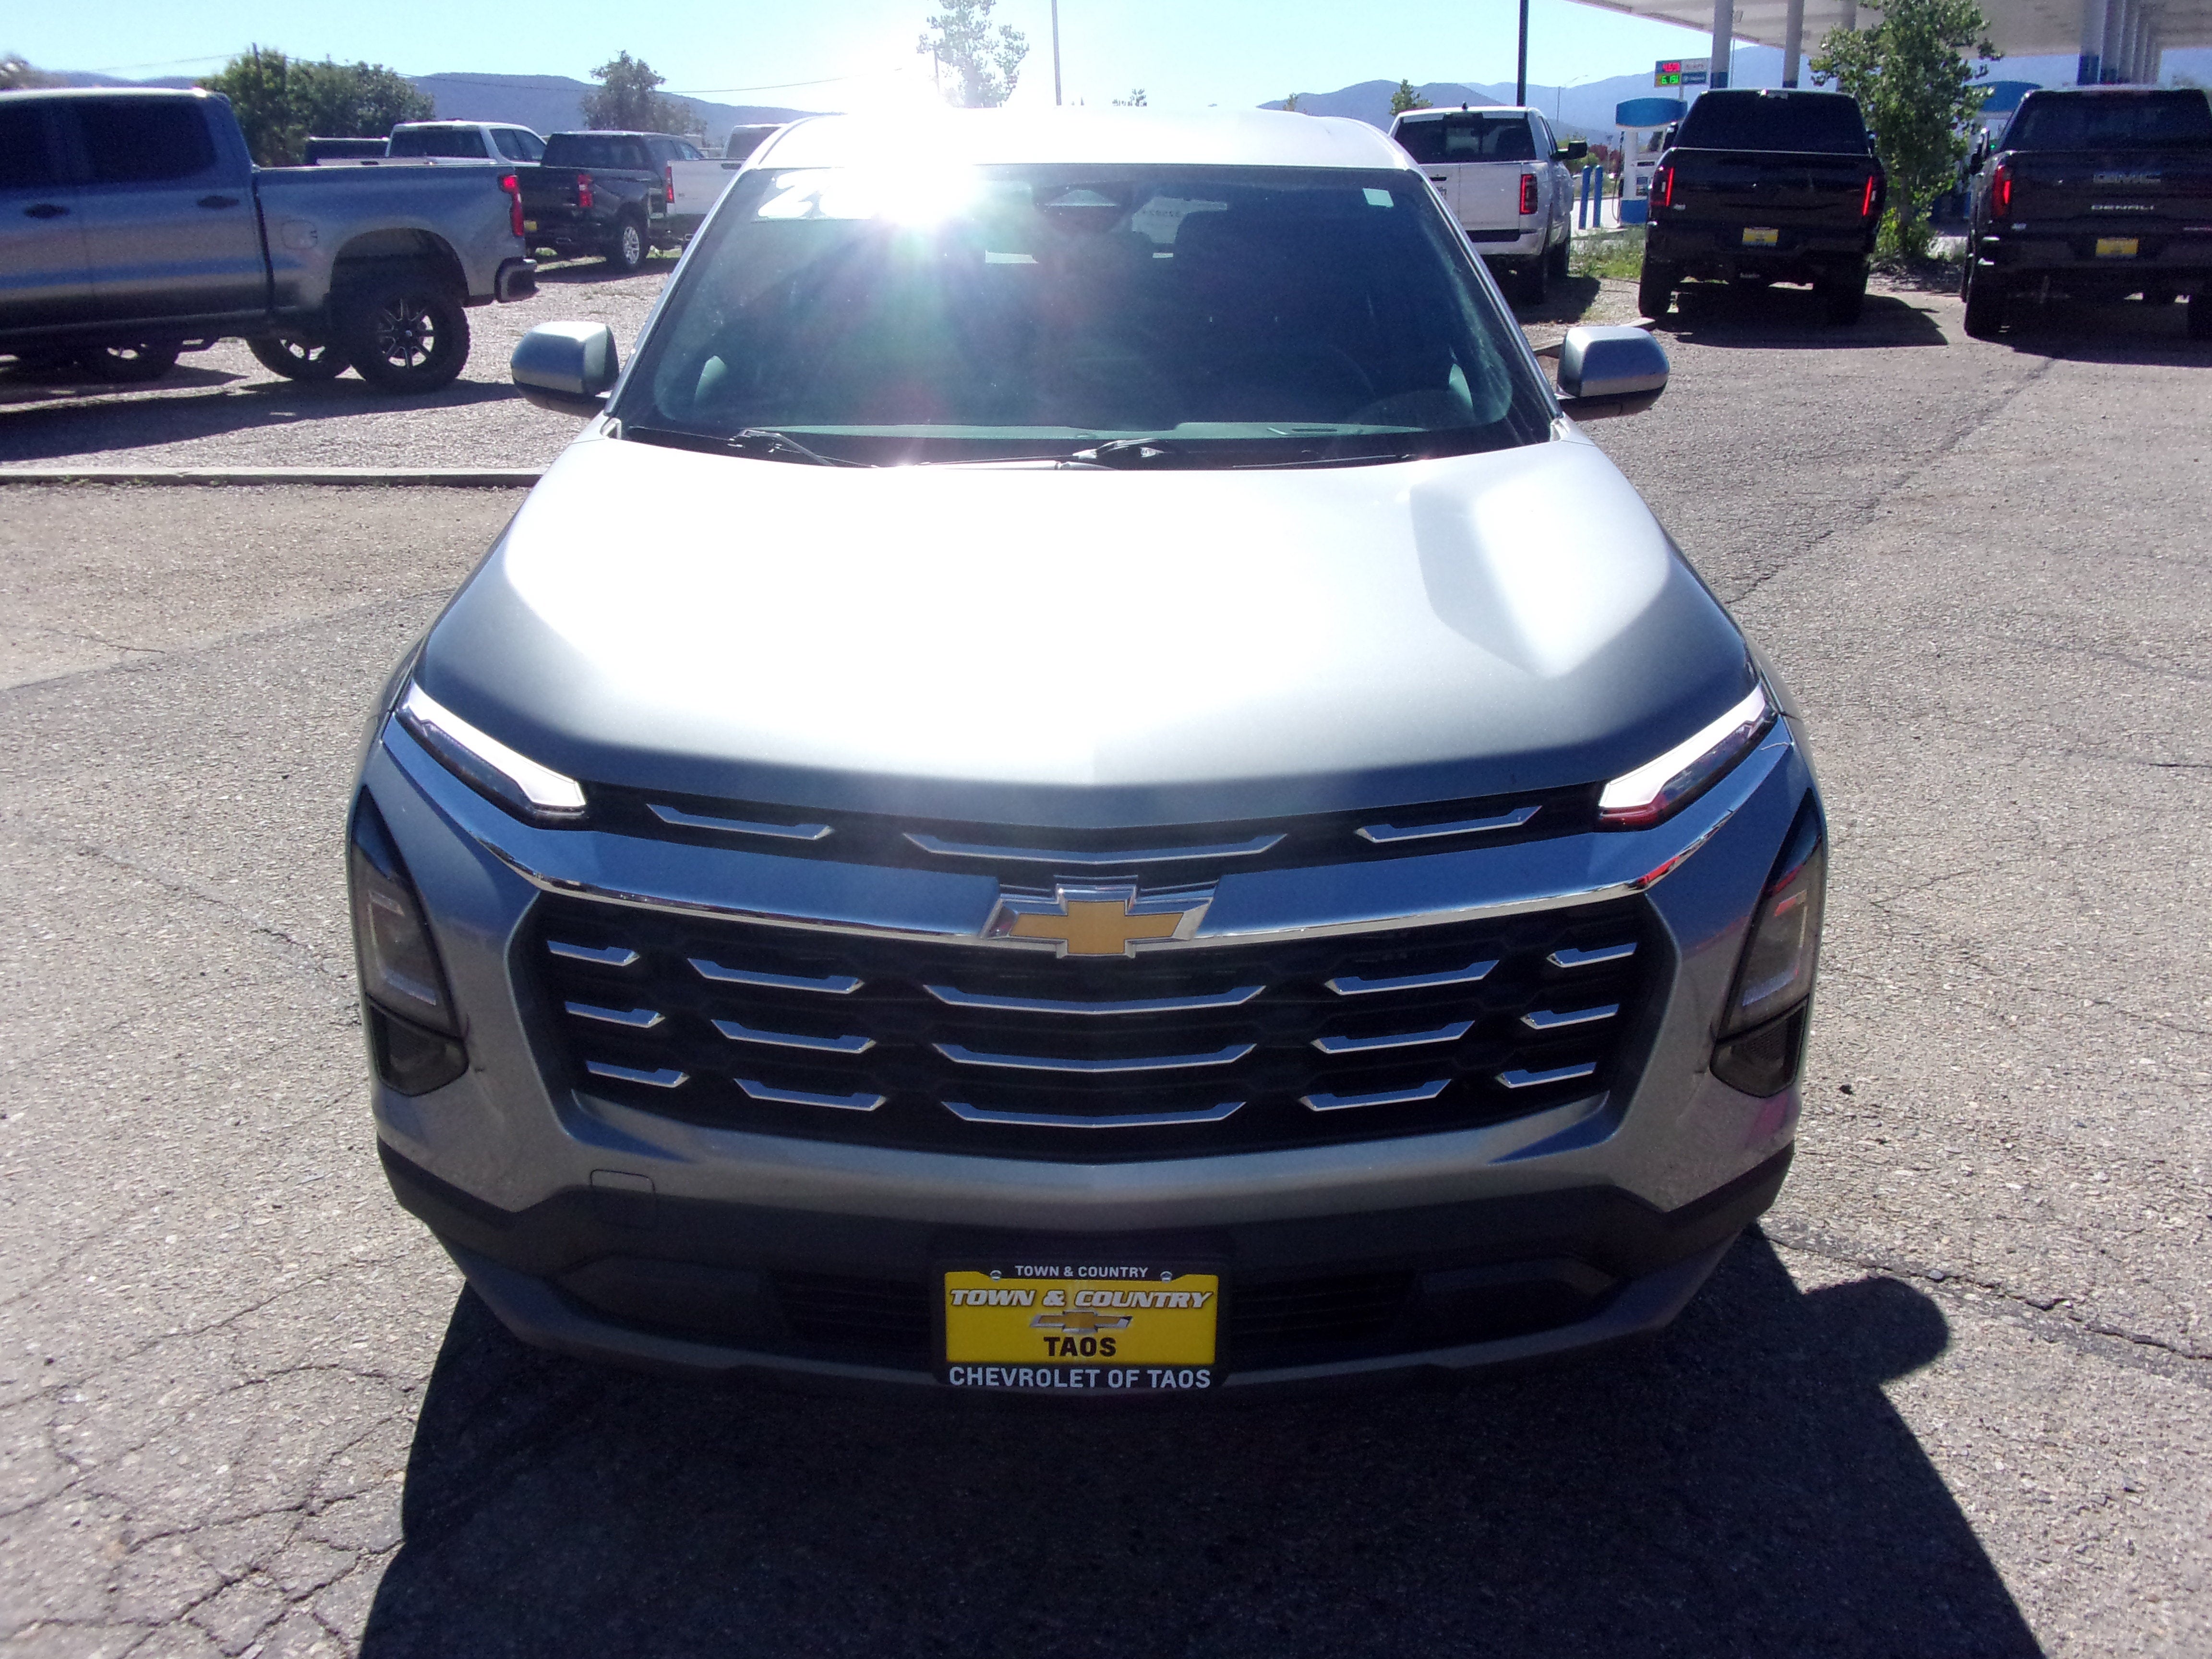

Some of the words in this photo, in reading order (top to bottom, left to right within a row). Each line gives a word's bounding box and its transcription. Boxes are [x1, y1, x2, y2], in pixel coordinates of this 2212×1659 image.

[1015, 1265, 1059, 1276] TOWN
[1063, 1266, 1073, 1277] &
[1078, 1266, 1148, 1278] COUNTRY
[950, 1289, 1036, 1306] TOWN
[1042, 1289, 1066, 1307] &
[1075, 1290, 1214, 1308] COUNTRY
[1043, 1336, 1116, 1357] TAOS
[949, 1367, 1101, 1388] CHEVROLET
[1108, 1369, 1140, 1388] OF
[1147, 1369, 1211, 1389] TAOS
